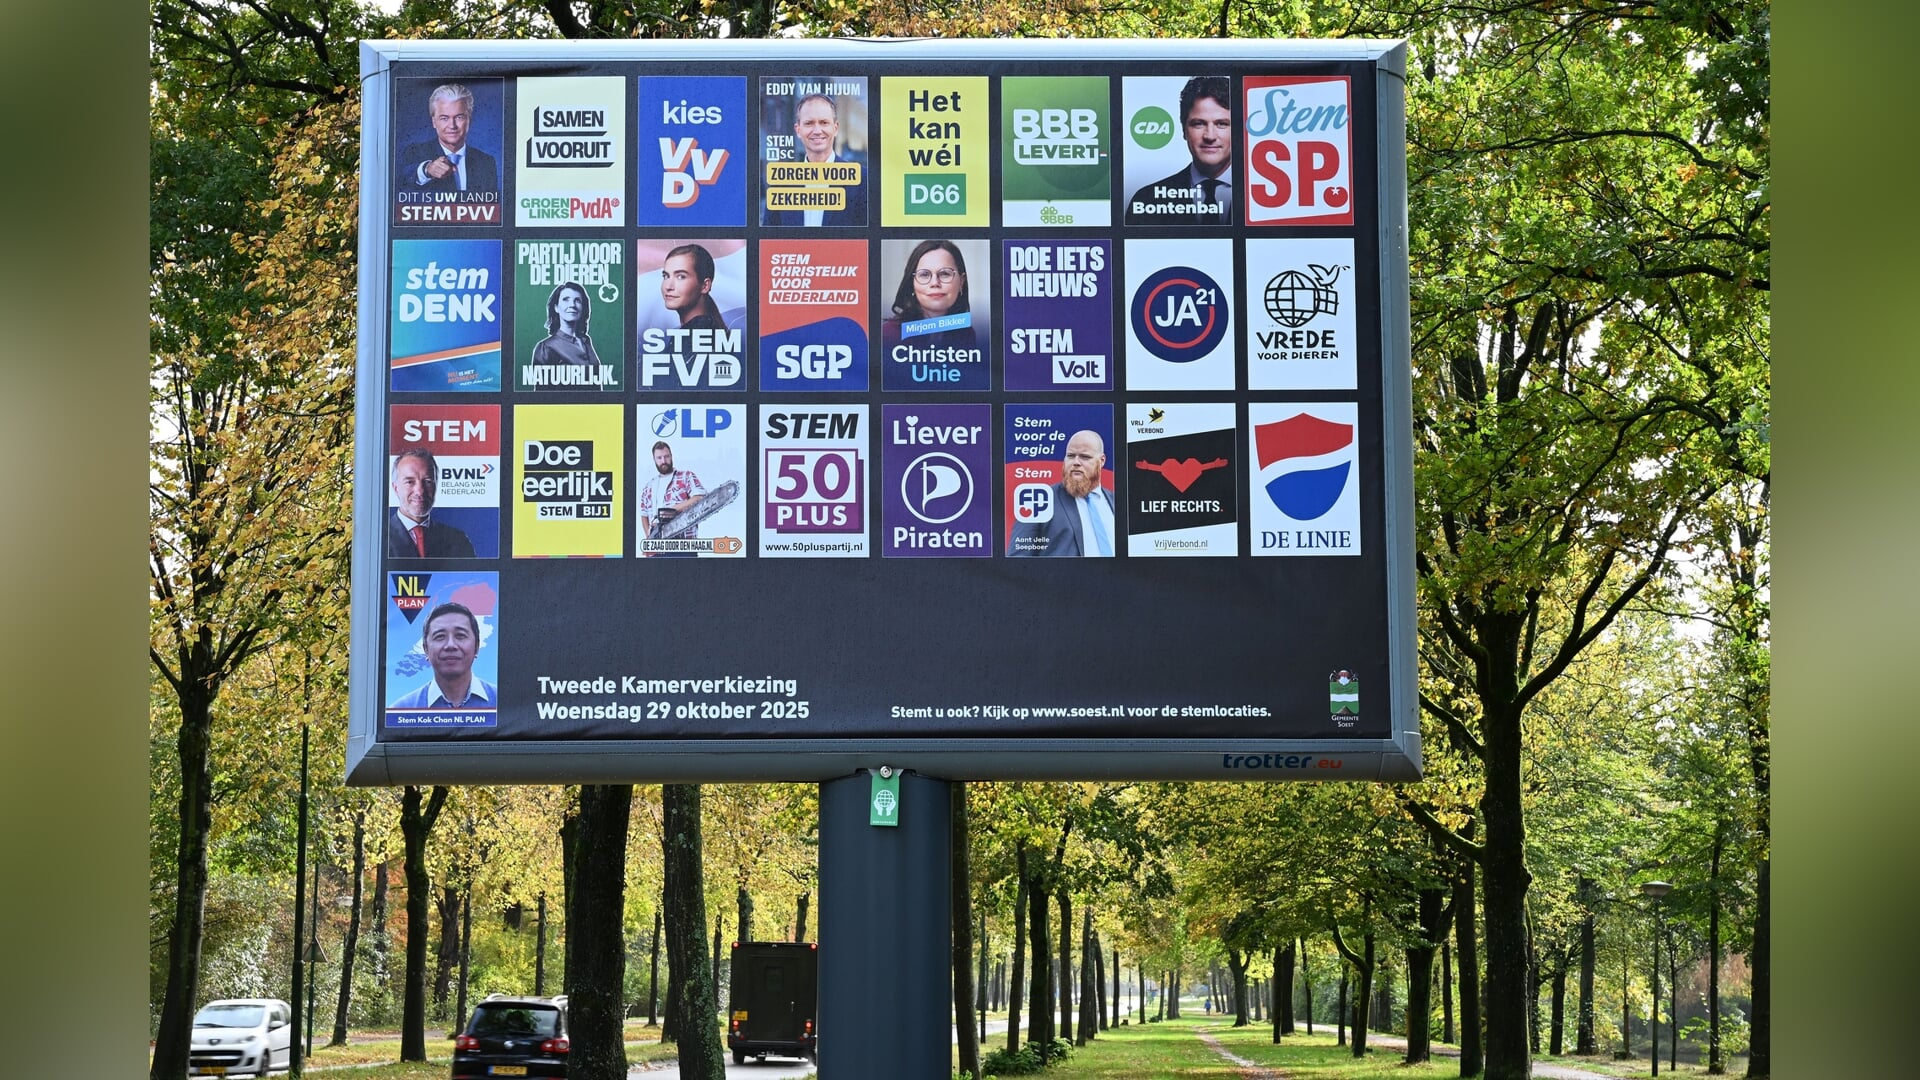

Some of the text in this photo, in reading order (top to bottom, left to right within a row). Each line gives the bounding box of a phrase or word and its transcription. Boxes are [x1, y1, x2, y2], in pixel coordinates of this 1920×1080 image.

[766, 82, 860, 96] EDDY VAN HIJUM
[909, 90, 961, 112] Het
[543, 111, 604, 127] SAMEN
[663, 100, 722, 124] kies
[1246, 89, 1349, 136] Stem
[909, 117, 961, 139] kan
[1013, 109, 1099, 139] BBB
[1134, 122, 1170, 134] CDA
[535, 141, 611, 159] VOORUIT
[766, 135, 794, 147] STEM
[909, 143, 961, 166] wél
[771, 167, 856, 180] ZORGEN VOOR
[398, 192, 498, 203] DIT IS UW LAND!
[771, 192, 841, 205] ZEKERHEID!
[911, 184, 960, 204] D66
[1154, 185, 1201, 199] Henri
[521, 198, 569, 208] GROEN
[570, 197, 613, 218] PvdA
[1132, 201, 1223, 214] Bontenbal
[401, 206, 495, 220] STEM PVV
[529, 208, 569, 219] LINKS
[1050, 215, 1073, 223] BBB
[519, 243, 621, 264] PARTIJ VOOR
[771, 254, 810, 264] STEM
[1010, 246, 1104, 270] DOE IETS
[406, 261, 489, 290] stem
[530, 264, 609, 286] DE DIEREN
[771, 266, 857, 277] CHRISTELIJK
[771, 278, 811, 288] VOOR
[1011, 273, 1097, 297] NIEUWS
[770, 292, 857, 303] NEDERLAND
[400, 293, 495, 322] DENK
[906, 316, 965, 334] Mirjam Bikker
[642, 328, 741, 353] STEM
[1011, 329, 1073, 353] STEM
[1256, 330, 1335, 349] VREDE
[776, 344, 852, 379] SGP
[892, 345, 981, 363] Christen
[1257, 351, 1339, 360] VOOR DIEREN
[523, 364, 618, 385] NATUURLIJK.
[642, 353, 741, 387] FVD
[911, 364, 961, 382] Unie
[1058, 360, 1099, 378] Volt
[404, 420, 486, 441] STEM
[681, 408, 732, 438] LP
[766, 413, 859, 439] STEM
[893, 416, 982, 444] Liever
[1014, 417, 1051, 427] Stem
[1014, 431, 1065, 441] voor de
[524, 441, 581, 465] Doe
[1014, 444, 1054, 457] regio!
[442, 469, 485, 479] BVNL
[775, 453, 850, 500] 50
[1015, 468, 1052, 478] Stem
[523, 472, 612, 502] eerlijk.
[540, 505, 608, 516] STEM BIJ1
[1141, 500, 1223, 512] LIEF RECHTS.
[777, 506, 847, 525] PLUS
[643, 541, 713, 550] DE ZAAG DOOR DEN HAAG.NL
[894, 526, 983, 548] Piraten
[1154, 540, 1208, 548] VrijVerbond.nl
[1262, 531, 1351, 548] DE LINIE
[766, 542, 863, 552] www.50pluspartij.nl
[398, 576, 424, 597] NL
[397, 599, 425, 607] PLAN
[537, 676, 797, 698] Tweede Kamerverkiezing
[398, 716, 416, 724] Stem
[418, 716, 432, 724] Kok
[537, 701, 809, 723] Woensdag 29 oktober 2025
[891, 705, 1271, 720] Stemt u ook? Kijk op www.soest.nl voor de stemlocaties.
[1223, 754, 1342, 769] trotter.eu
